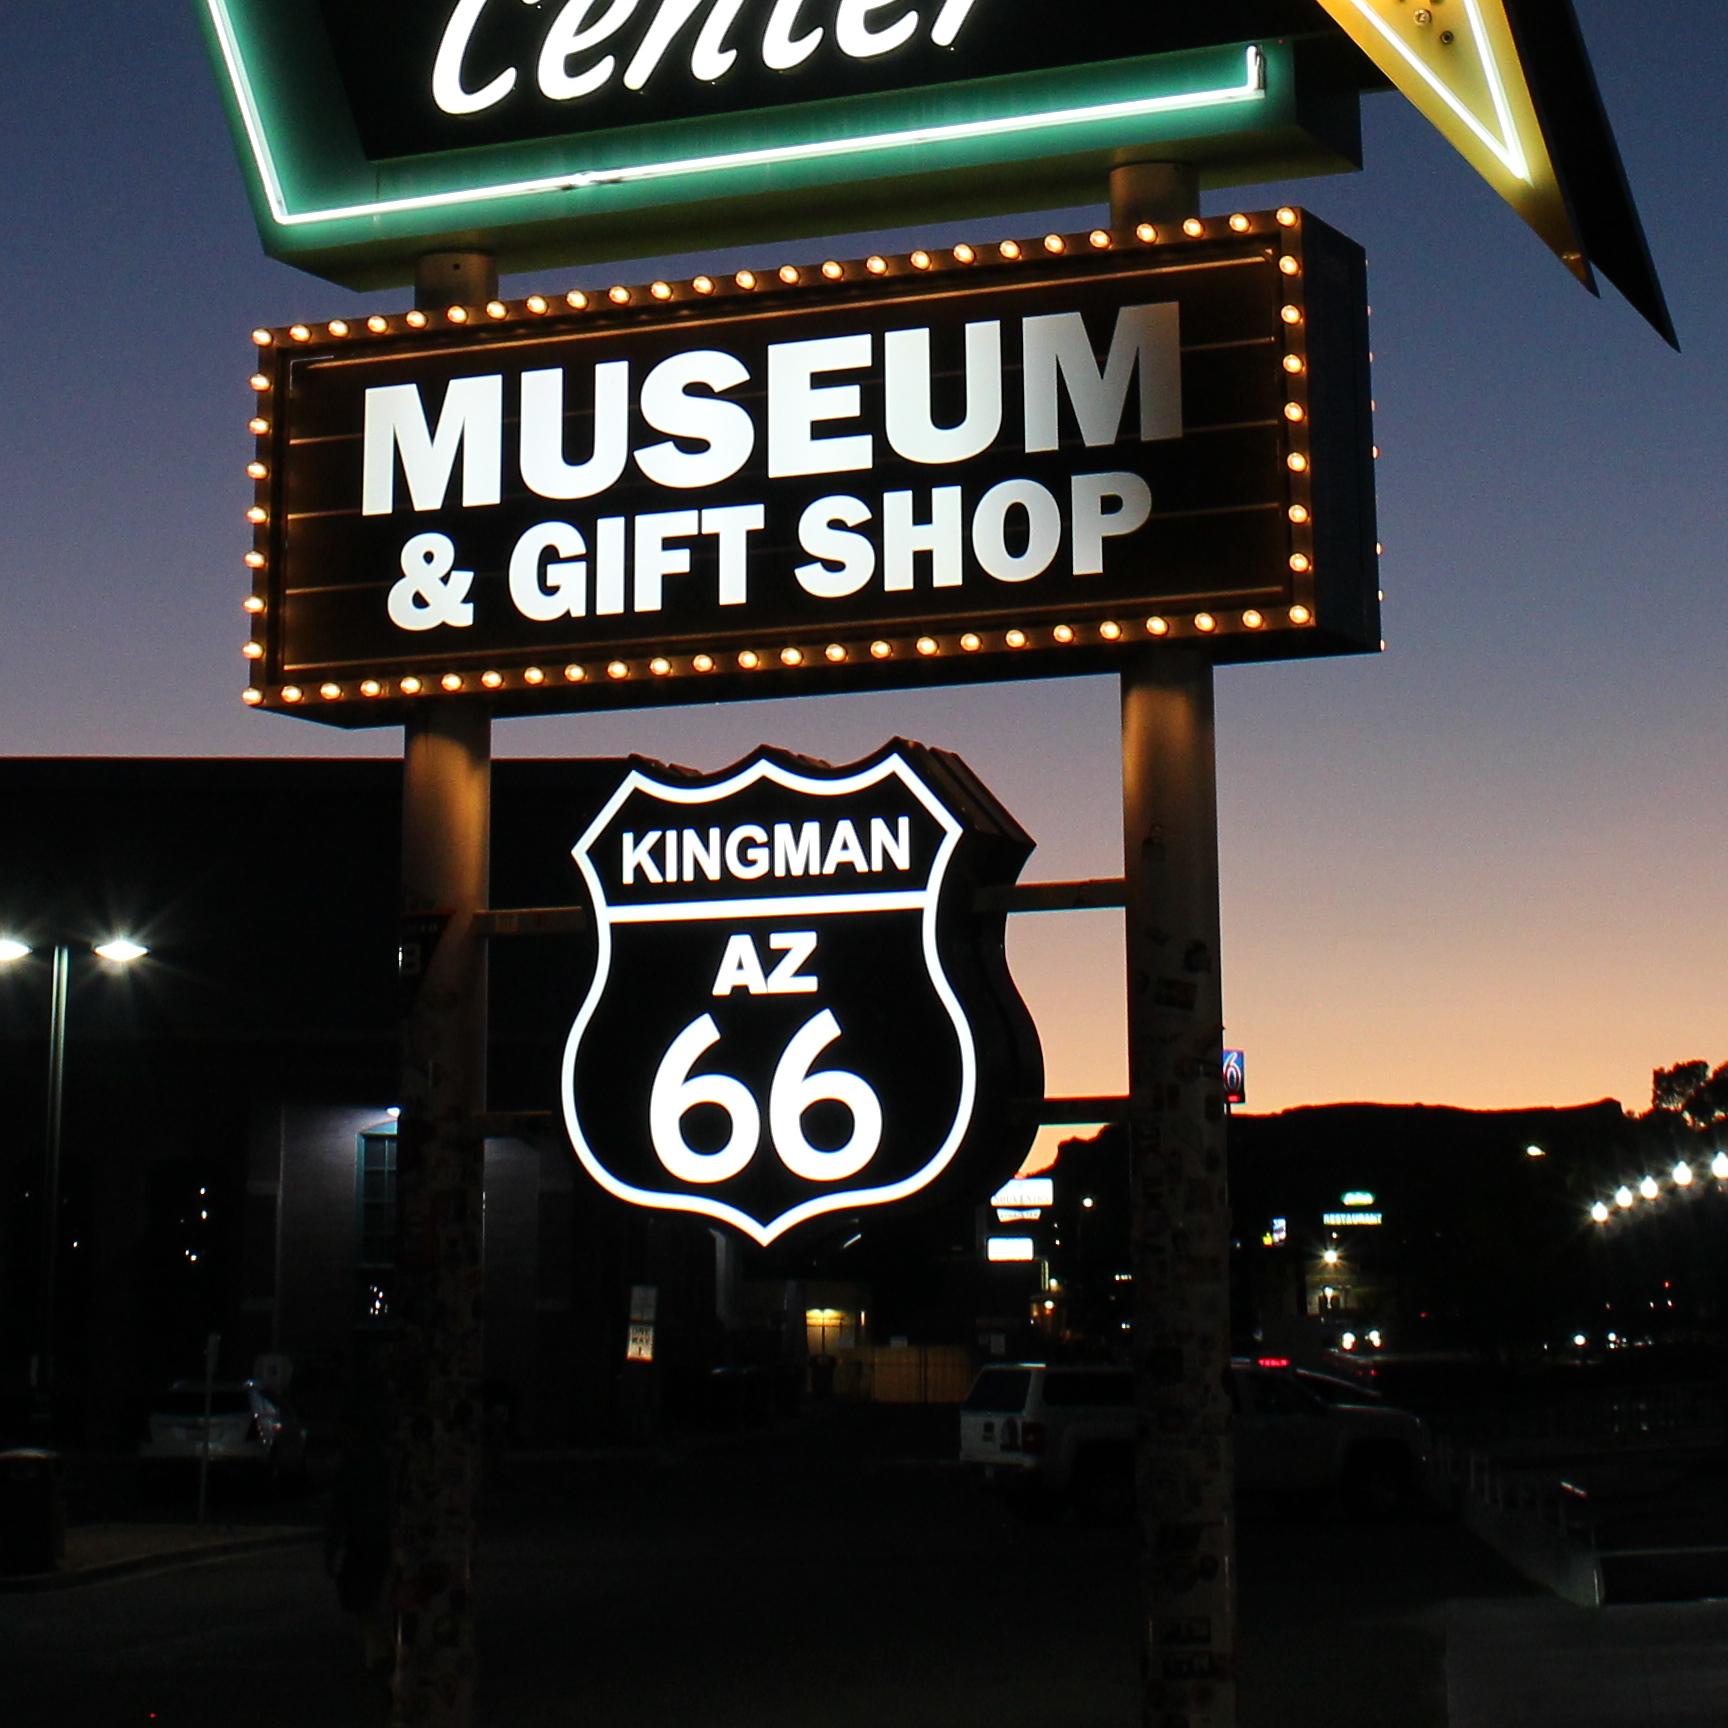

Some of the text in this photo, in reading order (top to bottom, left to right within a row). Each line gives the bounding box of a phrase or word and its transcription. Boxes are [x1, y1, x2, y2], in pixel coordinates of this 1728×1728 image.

[361, 300, 1184, 517] MUSEUM
[387, 471, 1153, 631] & GIFT SHOP
[622, 816, 910, 884] KINGMAN
[712, 931, 818, 996] AZ
[649, 1008, 883, 1182] 66
[1222, 1051, 1242, 1091] 6
